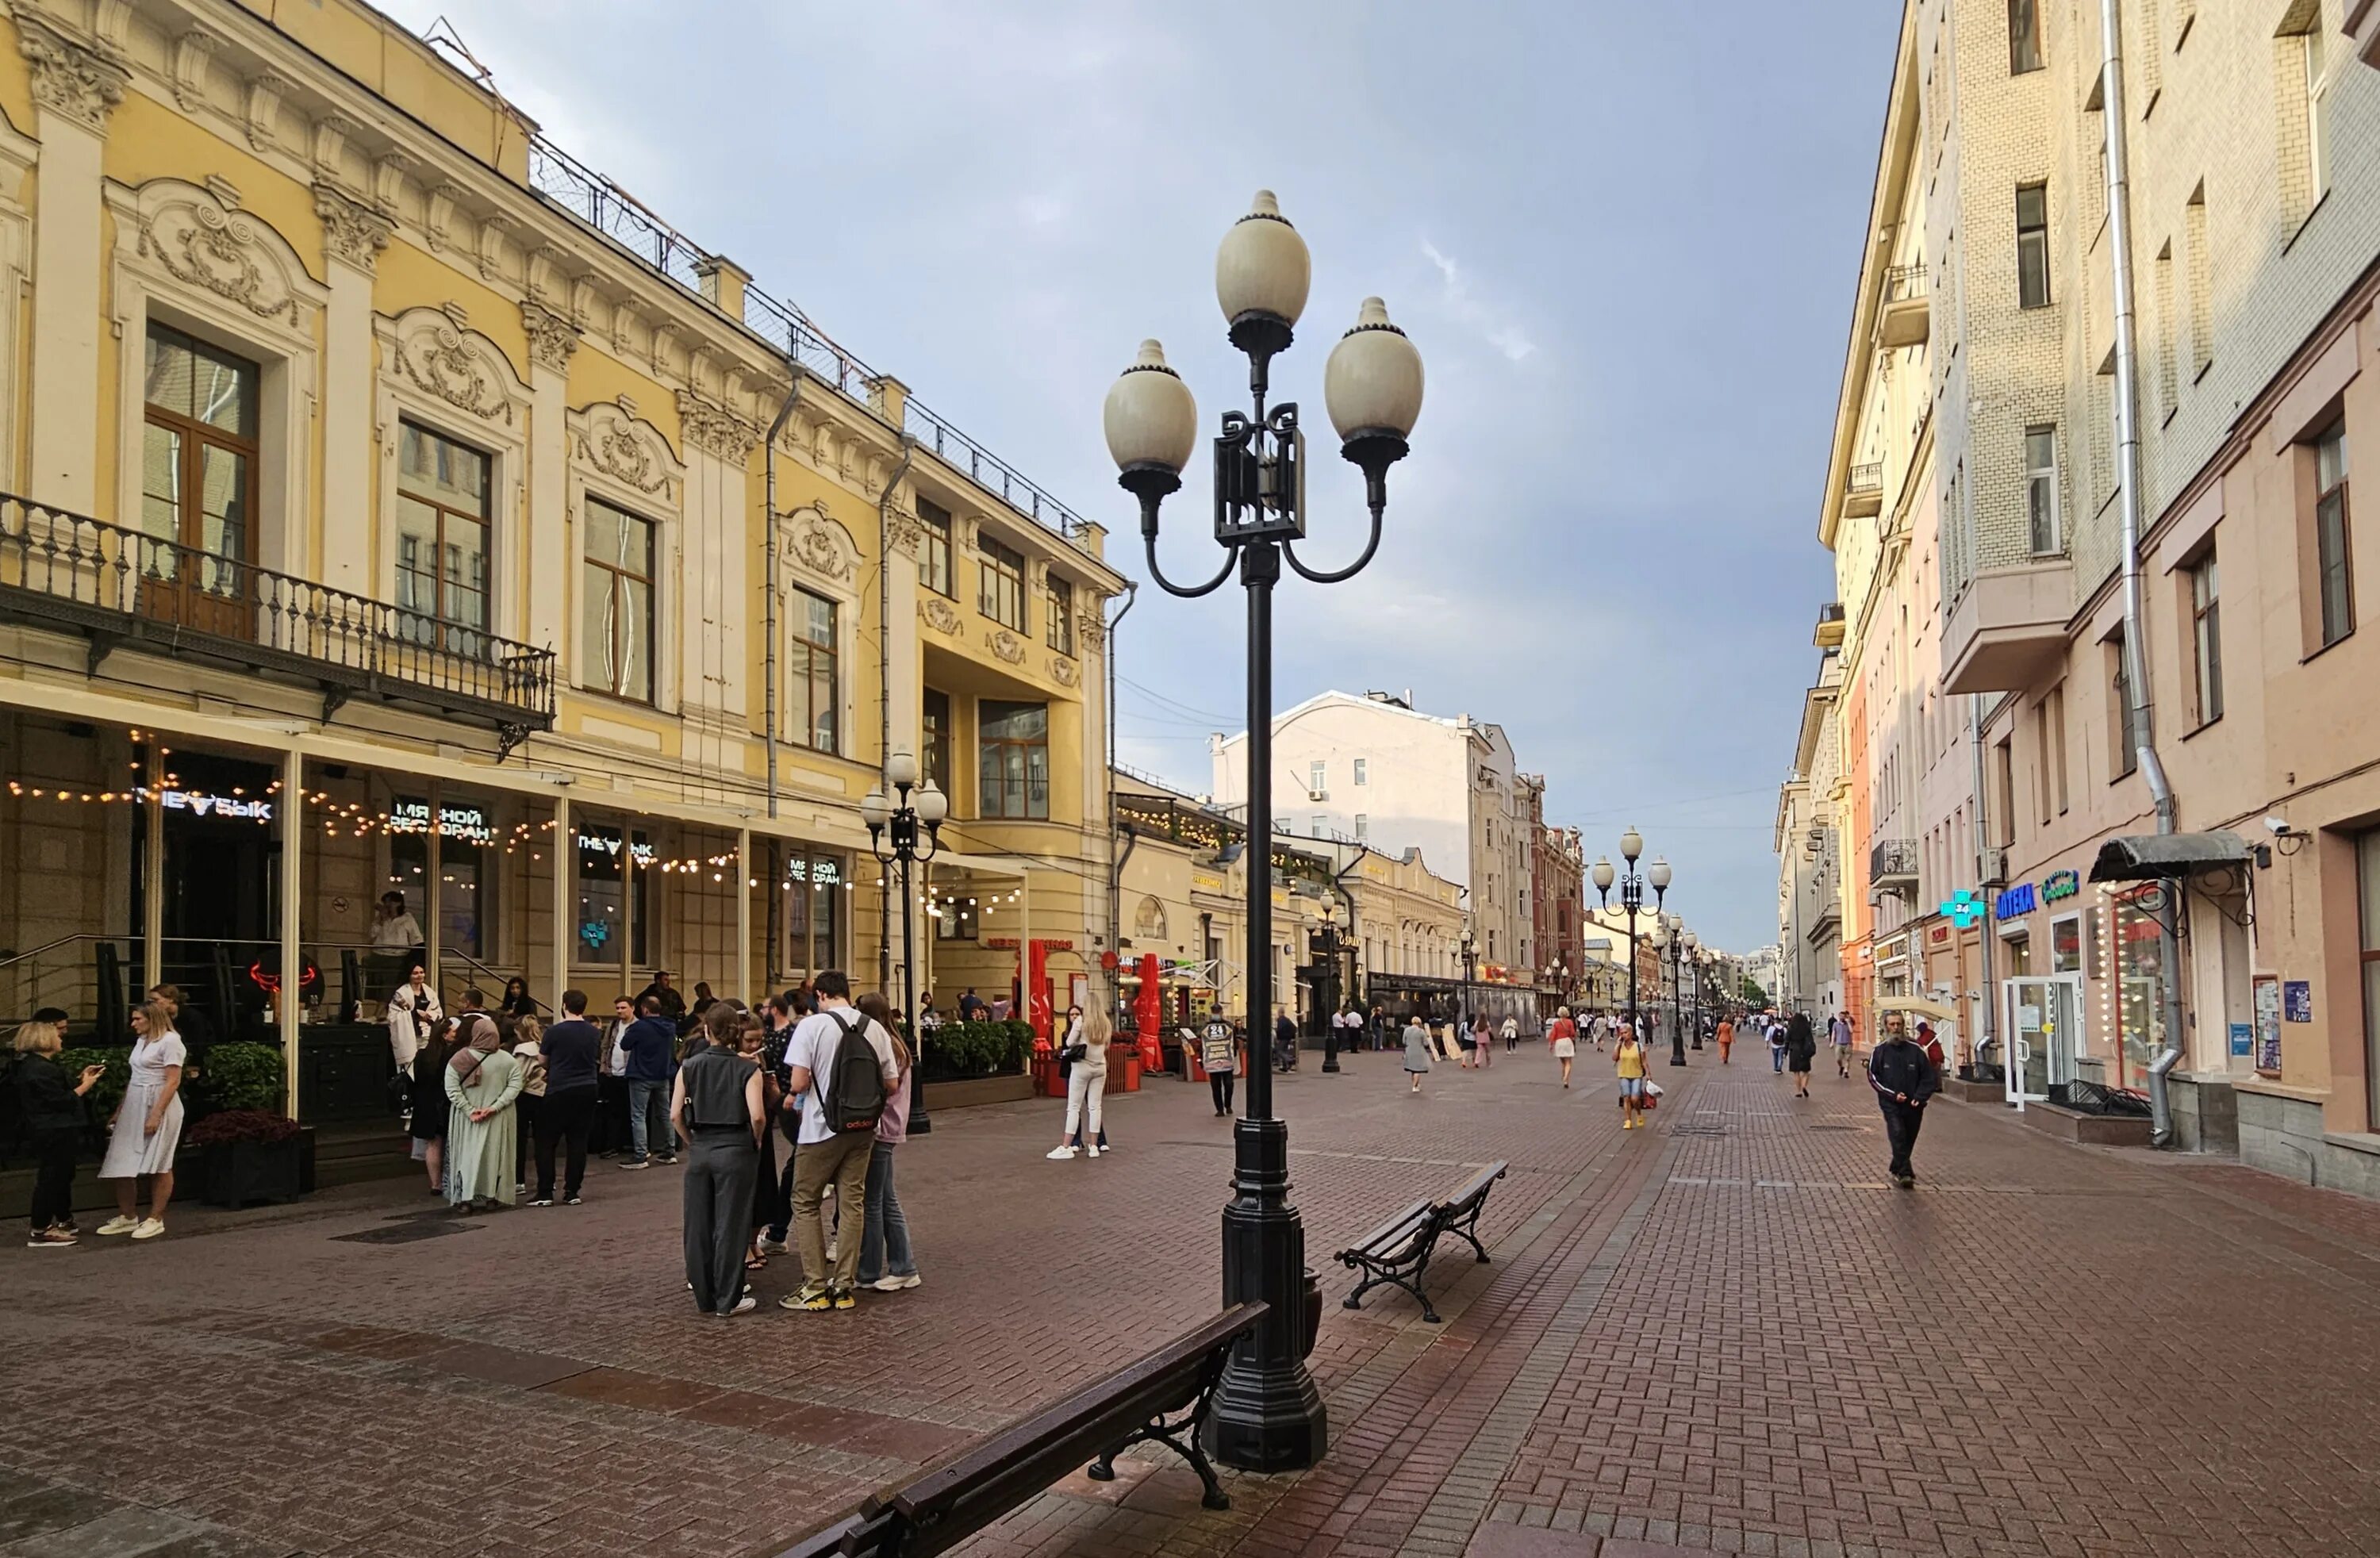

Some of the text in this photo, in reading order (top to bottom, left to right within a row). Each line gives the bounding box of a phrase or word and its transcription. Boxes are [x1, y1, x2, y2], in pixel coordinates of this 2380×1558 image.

[397, 803, 482, 826] МЯНОЙ
[390, 815, 489, 840] РЕСОРАН
[631, 842, 652, 857] ЫК
[790, 859, 835, 874] МЯНОЙ
[789, 870, 839, 885] ЕСОРАН
[1996, 883, 2036, 920] АПТЕКА
